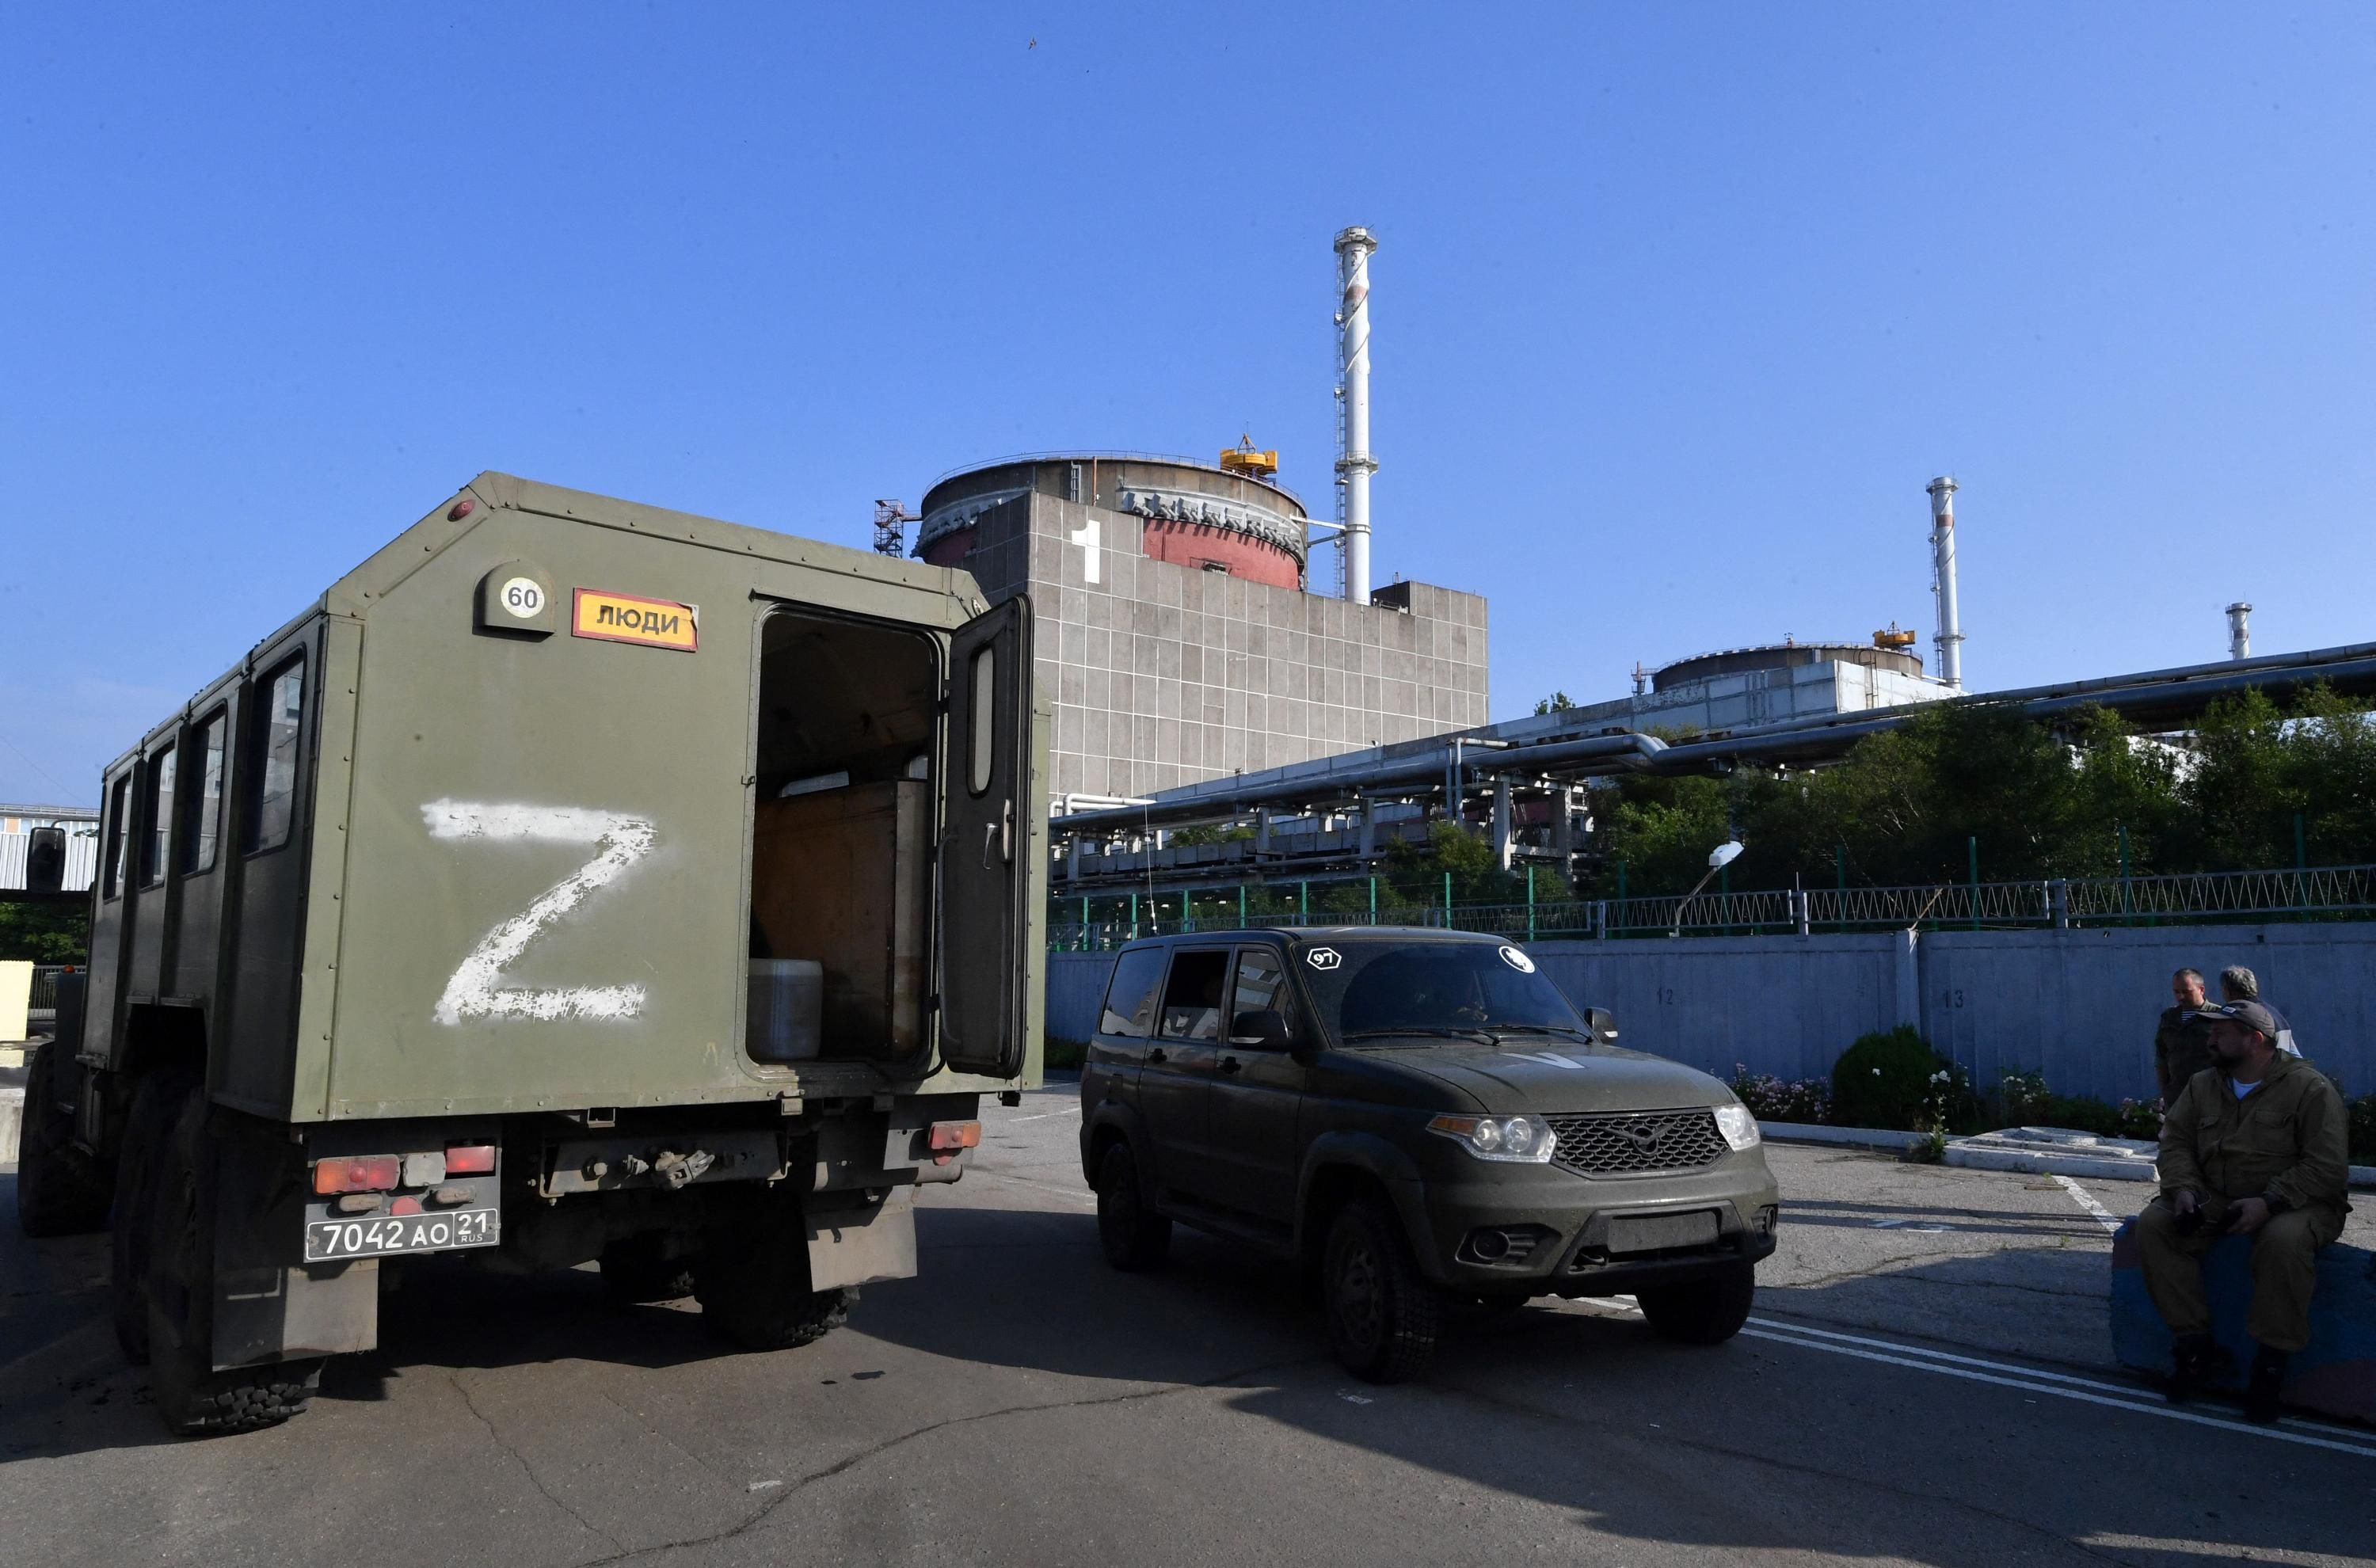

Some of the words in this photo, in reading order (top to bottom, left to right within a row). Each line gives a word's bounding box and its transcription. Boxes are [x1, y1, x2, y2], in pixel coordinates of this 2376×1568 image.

[1072, 519, 1100, 584] 1
[507, 586, 539, 609] 60
[596, 604, 679, 635] ЛЮДИ
[420, 797, 657, 1026] Z
[1313, 953, 1332, 965] 97
[1656, 988, 1673, 1005] 12
[1943, 989, 1963, 1008] 13
[458, 1212, 487, 1235] 21
[322, 1220, 404, 1254] 7042
[460, 1234, 483, 1243] RUS
